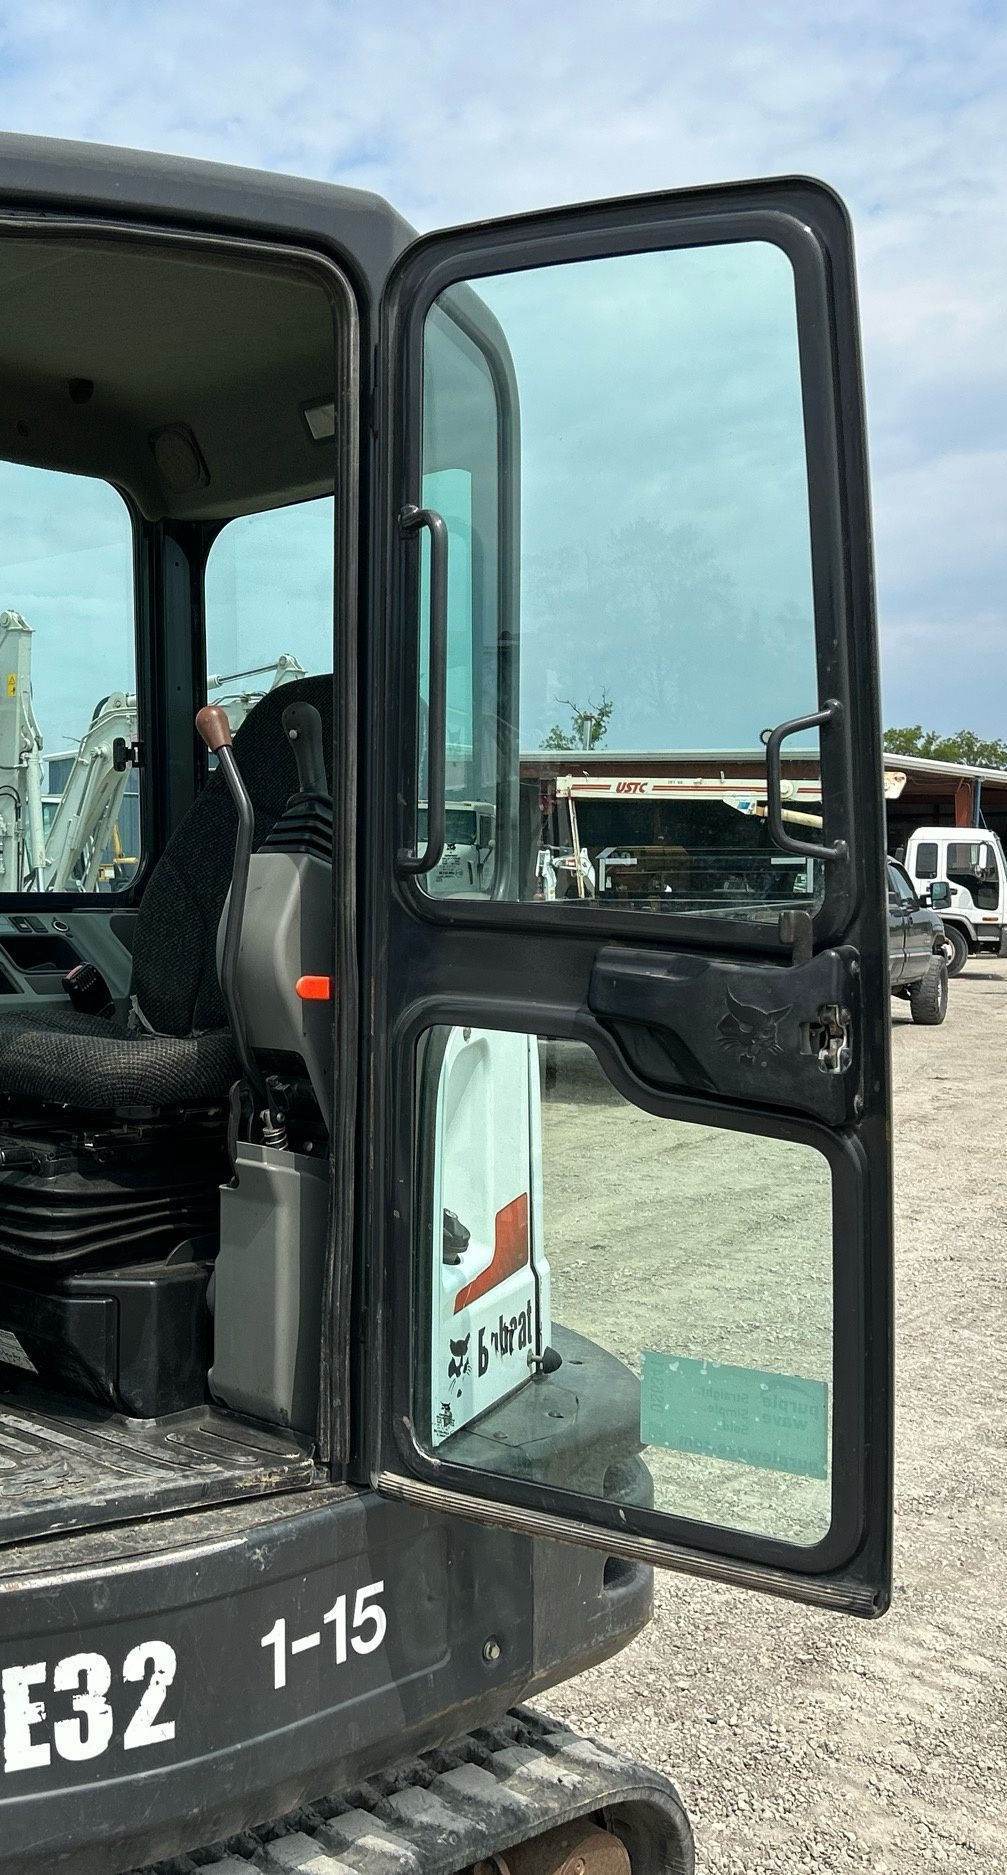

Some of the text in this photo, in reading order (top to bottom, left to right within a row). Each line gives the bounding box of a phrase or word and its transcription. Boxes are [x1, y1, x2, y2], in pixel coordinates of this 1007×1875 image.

[615, 781, 648, 793] USTC
[261, 1580, 387, 1690] 1-15
[2, 1640, 177, 1773] E32
